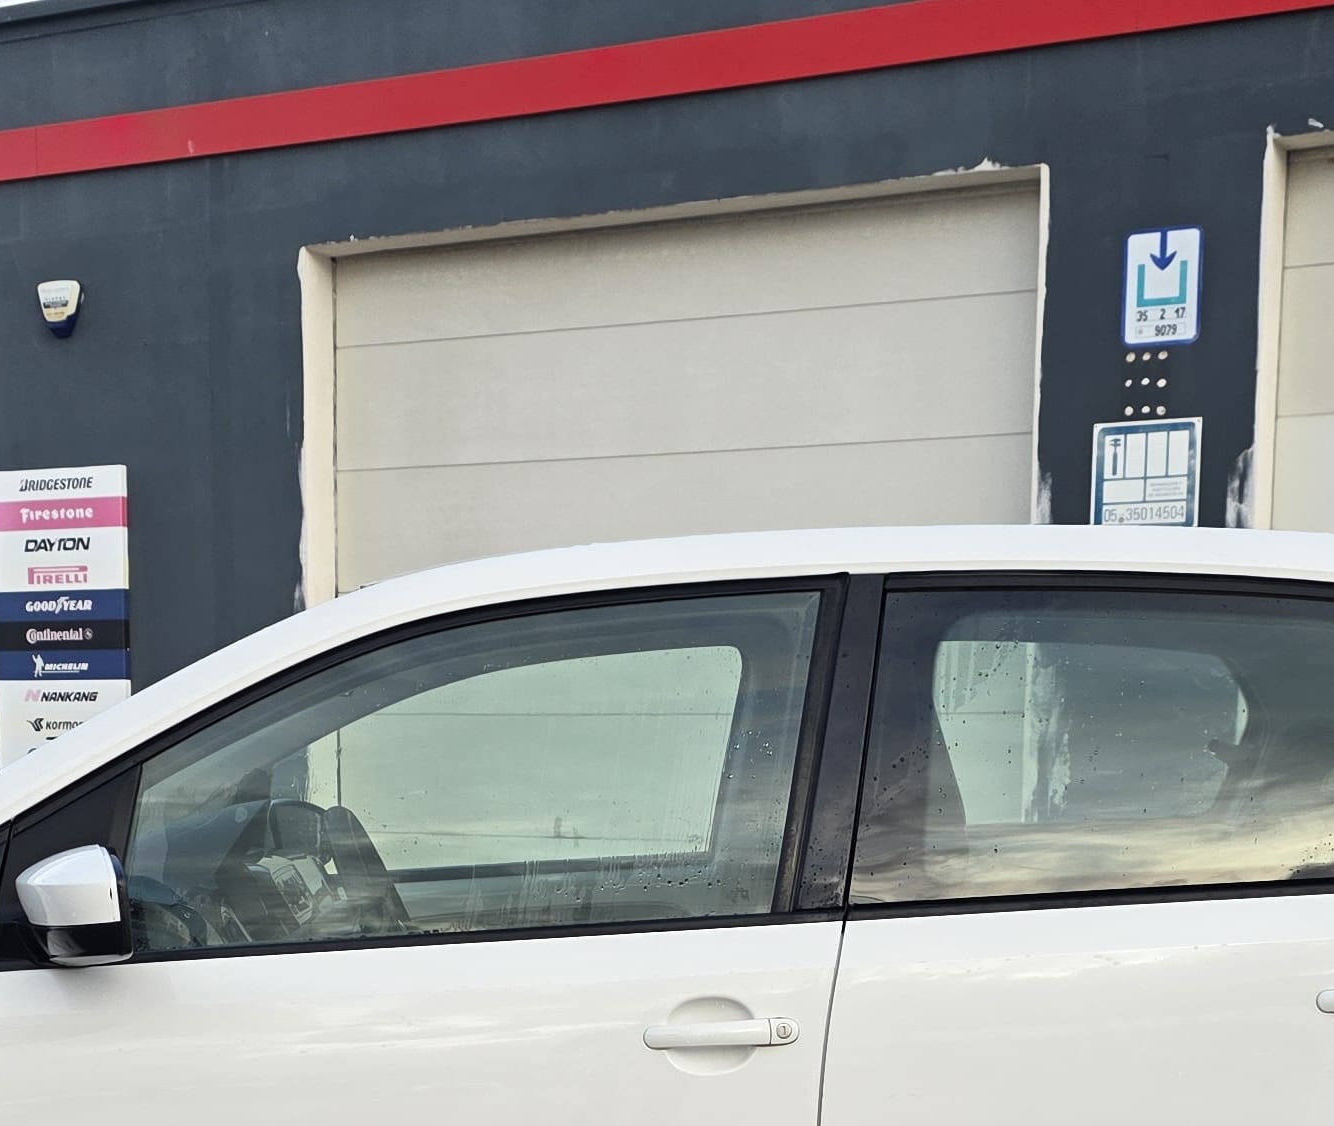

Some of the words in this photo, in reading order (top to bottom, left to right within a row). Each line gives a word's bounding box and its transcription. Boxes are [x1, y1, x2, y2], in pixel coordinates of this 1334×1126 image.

[1159, 308, 1166, 320] 2
[1154, 323, 1177, 336] 9079
[19, 476, 93, 492] BRIDGESTONE
[20, 506, 93, 524] Firestone
[24, 537, 90, 552] DAYTON
[28, 565, 88, 585] PIRELLI
[25, 596, 92, 614] GOODYEAR
[26, 627, 84, 644] Continental
[43, 662, 89, 672] MICHELIN
[41, 691, 98, 702] NANKANG
